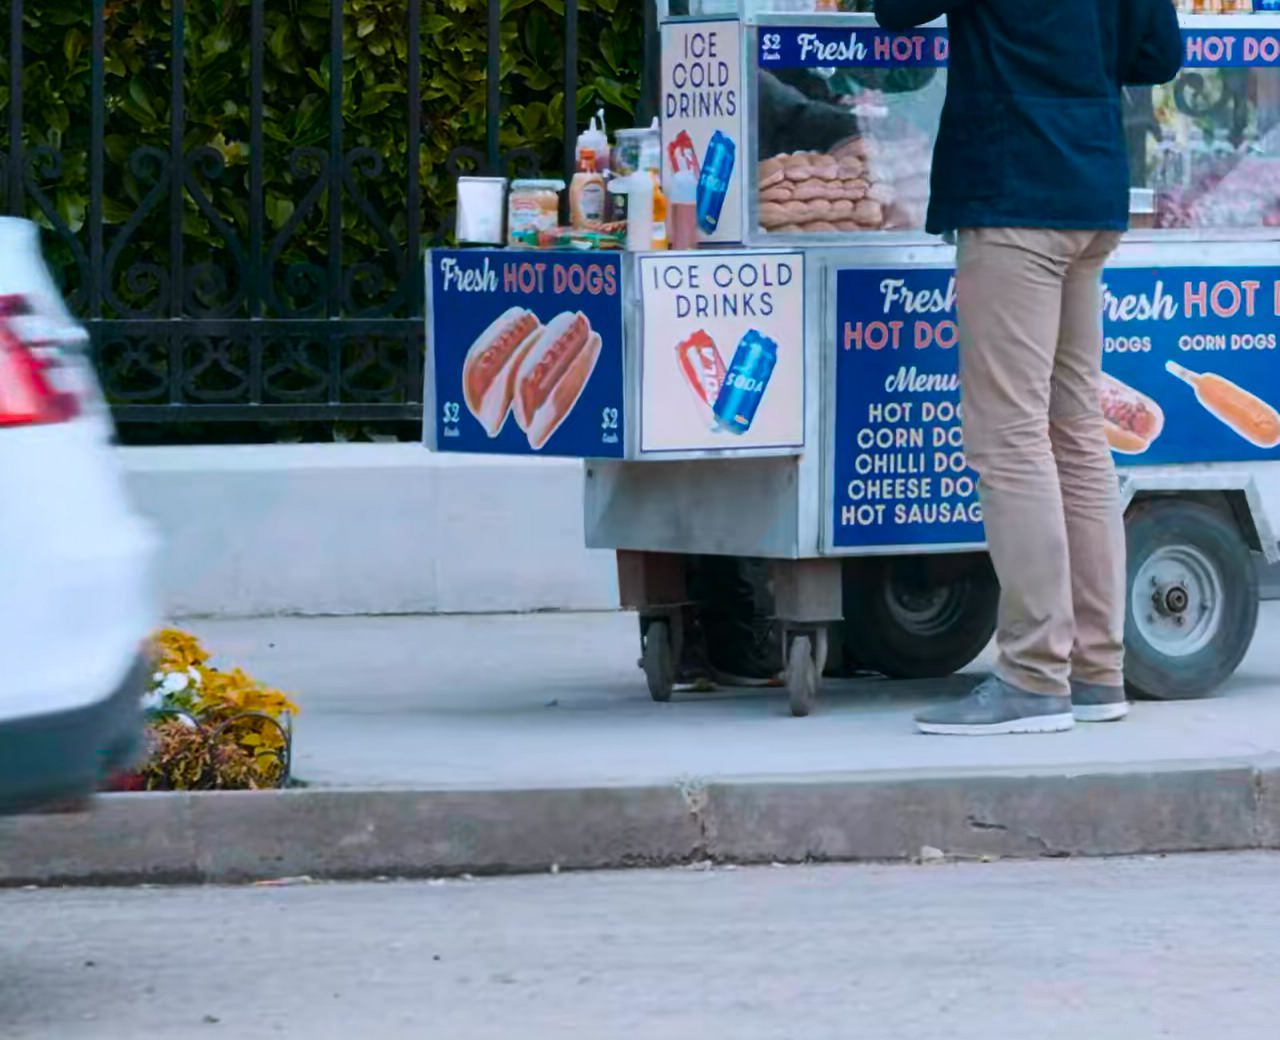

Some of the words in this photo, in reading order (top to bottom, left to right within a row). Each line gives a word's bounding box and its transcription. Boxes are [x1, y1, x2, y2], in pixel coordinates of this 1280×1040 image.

[684, 32, 717, 58] ICE
[762, 33, 781, 50] $2
[797, 32, 868, 61] Fresh
[873, 35, 925, 61] HOT
[1186, 36, 1236, 62] HOT
[672, 61, 729, 89] COLD
[666, 90, 737, 119] DRINKS
[440, 256, 499, 292] Fresh
[503, 263, 547, 294] HOT
[553, 264, 617, 296] DOGS
[653, 265, 700, 289] ICE
[713, 263, 792, 288] COLD
[676, 292, 774, 319] DRINKS
[1101, 280, 1178, 322] resh
[1183, 280, 1260, 318] HOT
[844, 321, 904, 350] HOT
[914, 320, 960, 349] DO
[1104, 336, 1152, 353] DOGS
[1178, 334, 1226, 351] CORN
[1231, 333, 1277, 350] DOGS
[884, 366, 960, 393] Menu
[868, 402, 913, 423] HOT
[922, 401, 963, 422] DO
[857, 427, 924, 449] CORN
[932, 426, 964, 447] DO
[854, 453, 925, 475] CHILLI
[934, 452, 967, 473] DO
[847, 477, 932, 500] CHEESE
[940, 476, 978, 498] DO
[841, 503, 886, 526] HOT
[894, 502, 983, 525] SAUSAG
